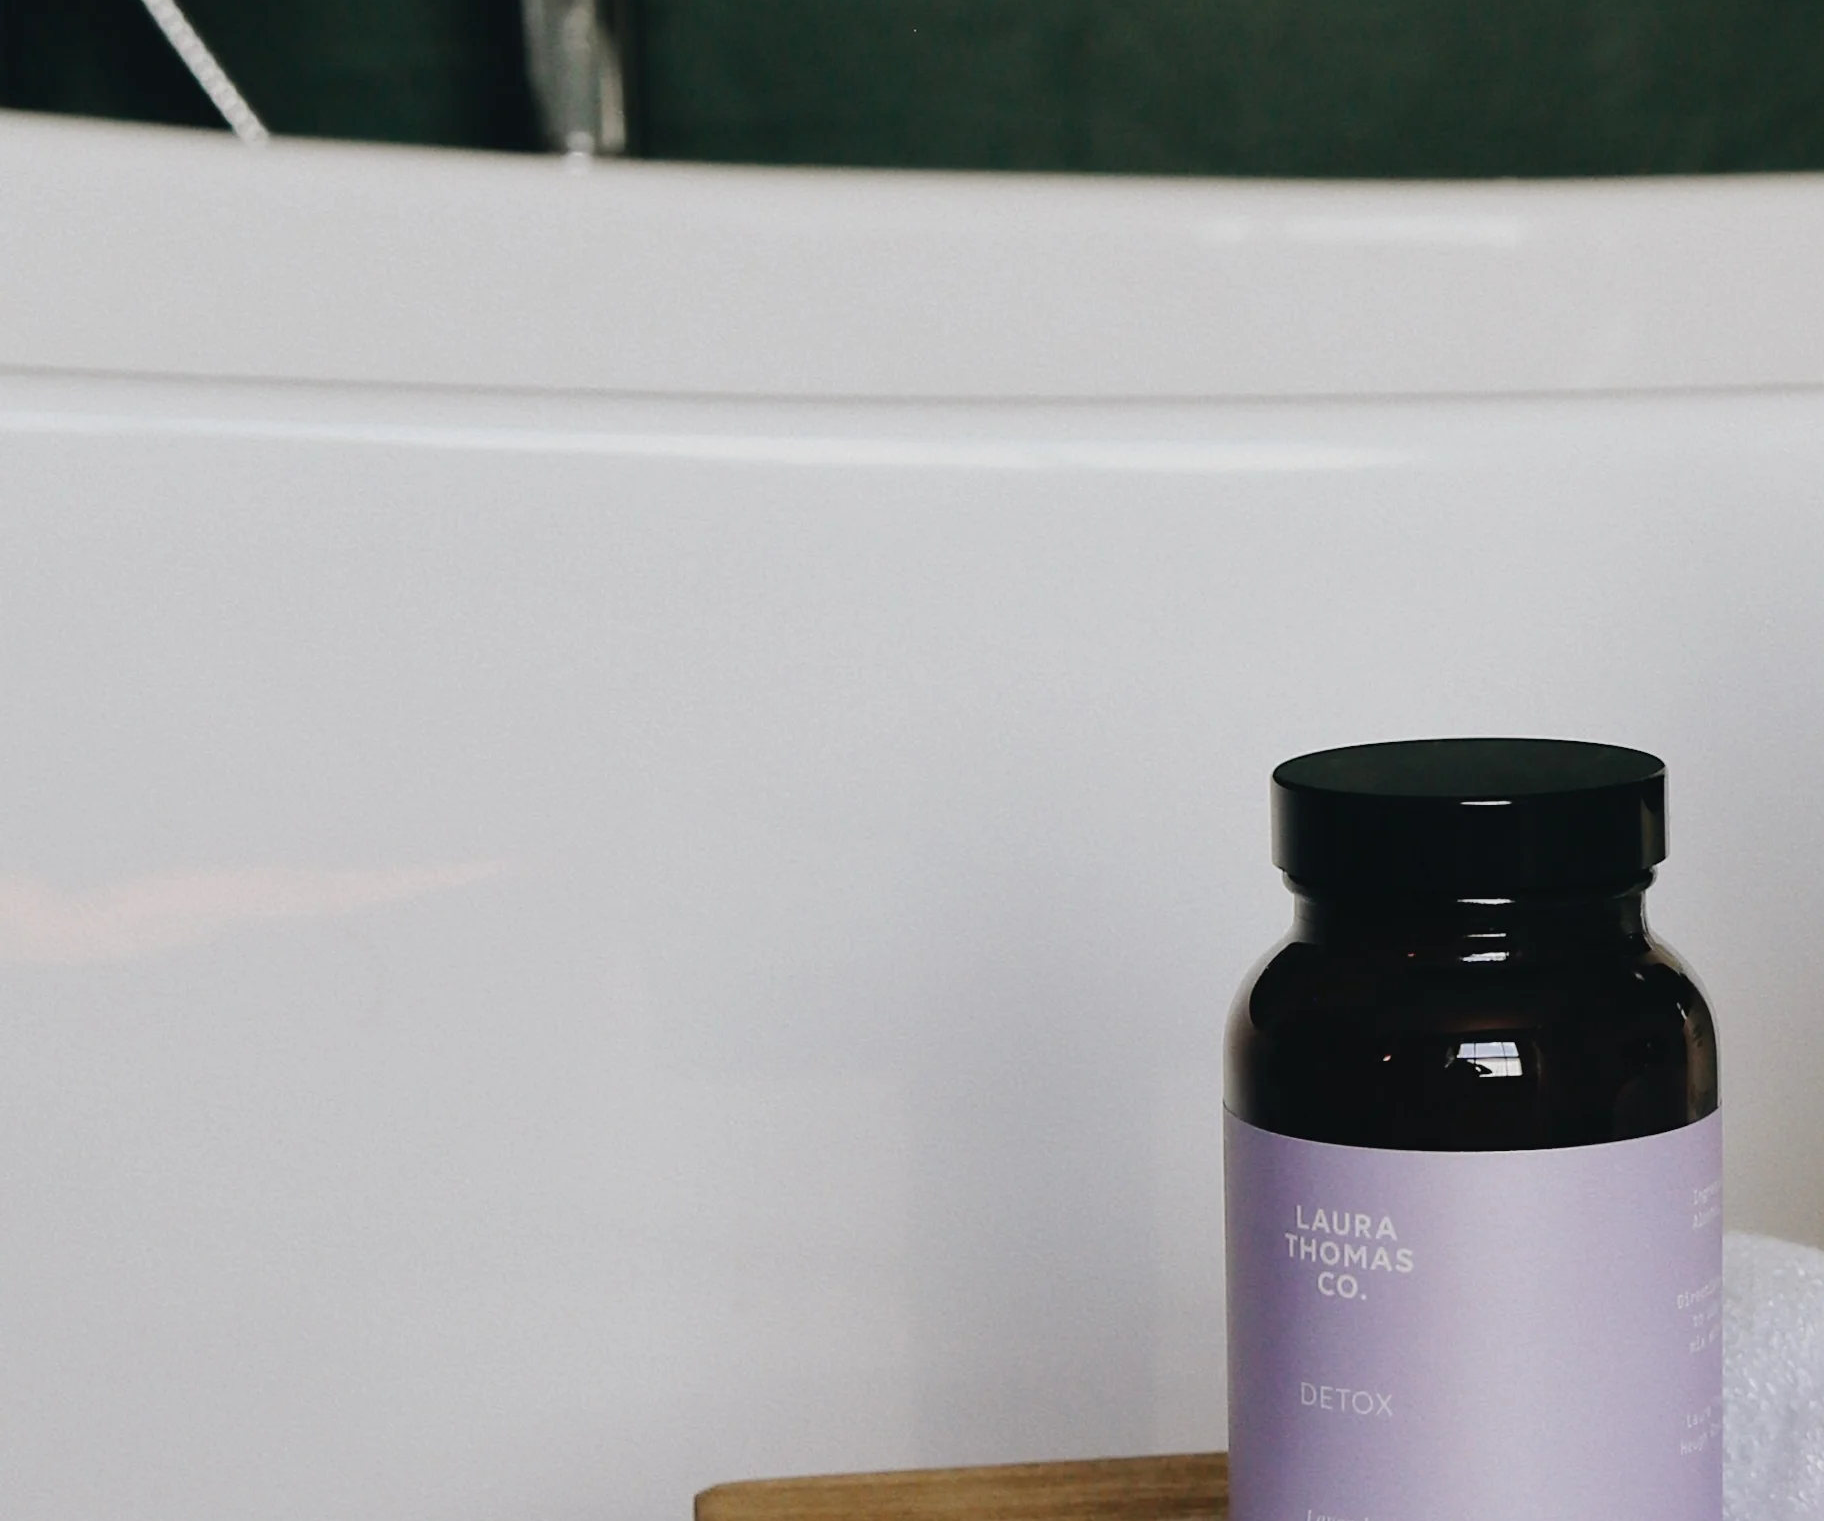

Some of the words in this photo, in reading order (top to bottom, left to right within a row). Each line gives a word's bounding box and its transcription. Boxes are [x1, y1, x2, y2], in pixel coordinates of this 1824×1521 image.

[1296, 1204, 1397, 1241] LAURA
[1285, 1232, 1414, 1273] THOMAS
[1318, 1271, 1367, 1300] CO.
[1301, 1382, 1393, 1417] DETOX
